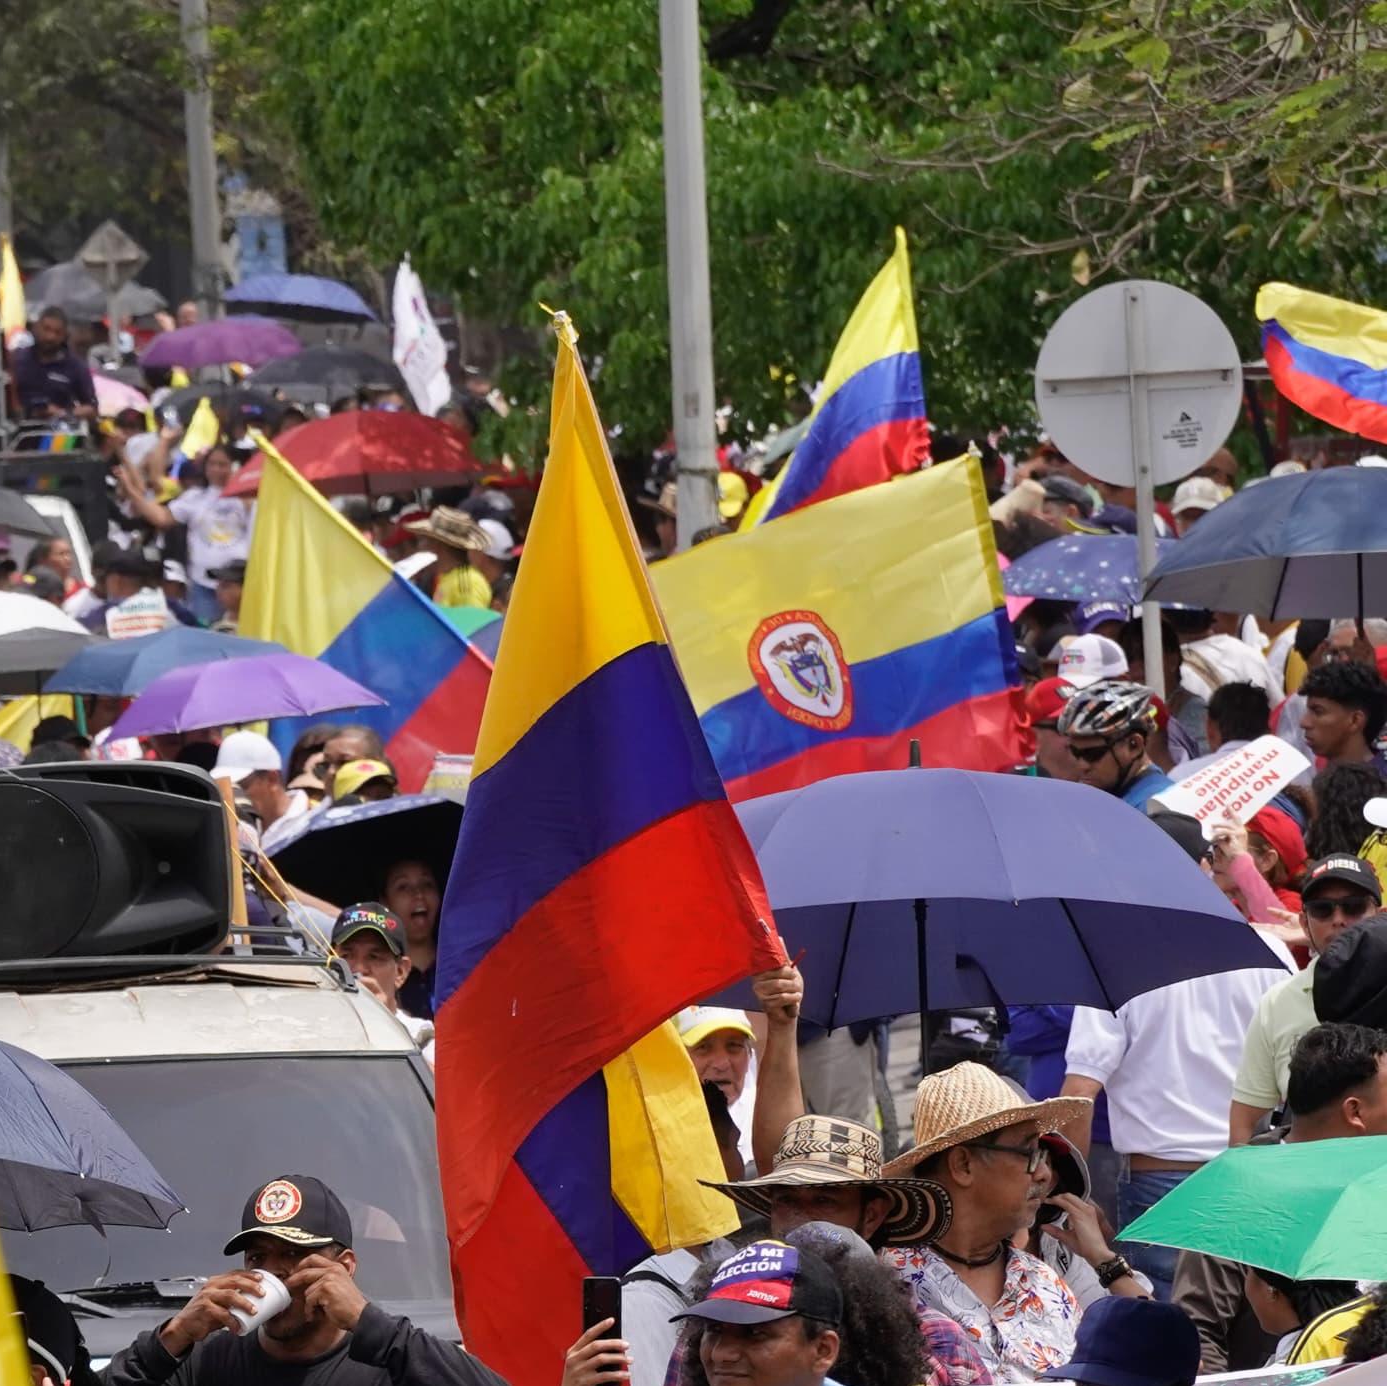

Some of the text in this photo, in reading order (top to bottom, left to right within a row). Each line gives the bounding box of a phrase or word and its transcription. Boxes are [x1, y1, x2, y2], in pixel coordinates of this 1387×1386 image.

[1252, 769, 1281, 793] No
[1327, 859, 1362, 873] DIESEL
[759, 1247, 785, 1258] MI
